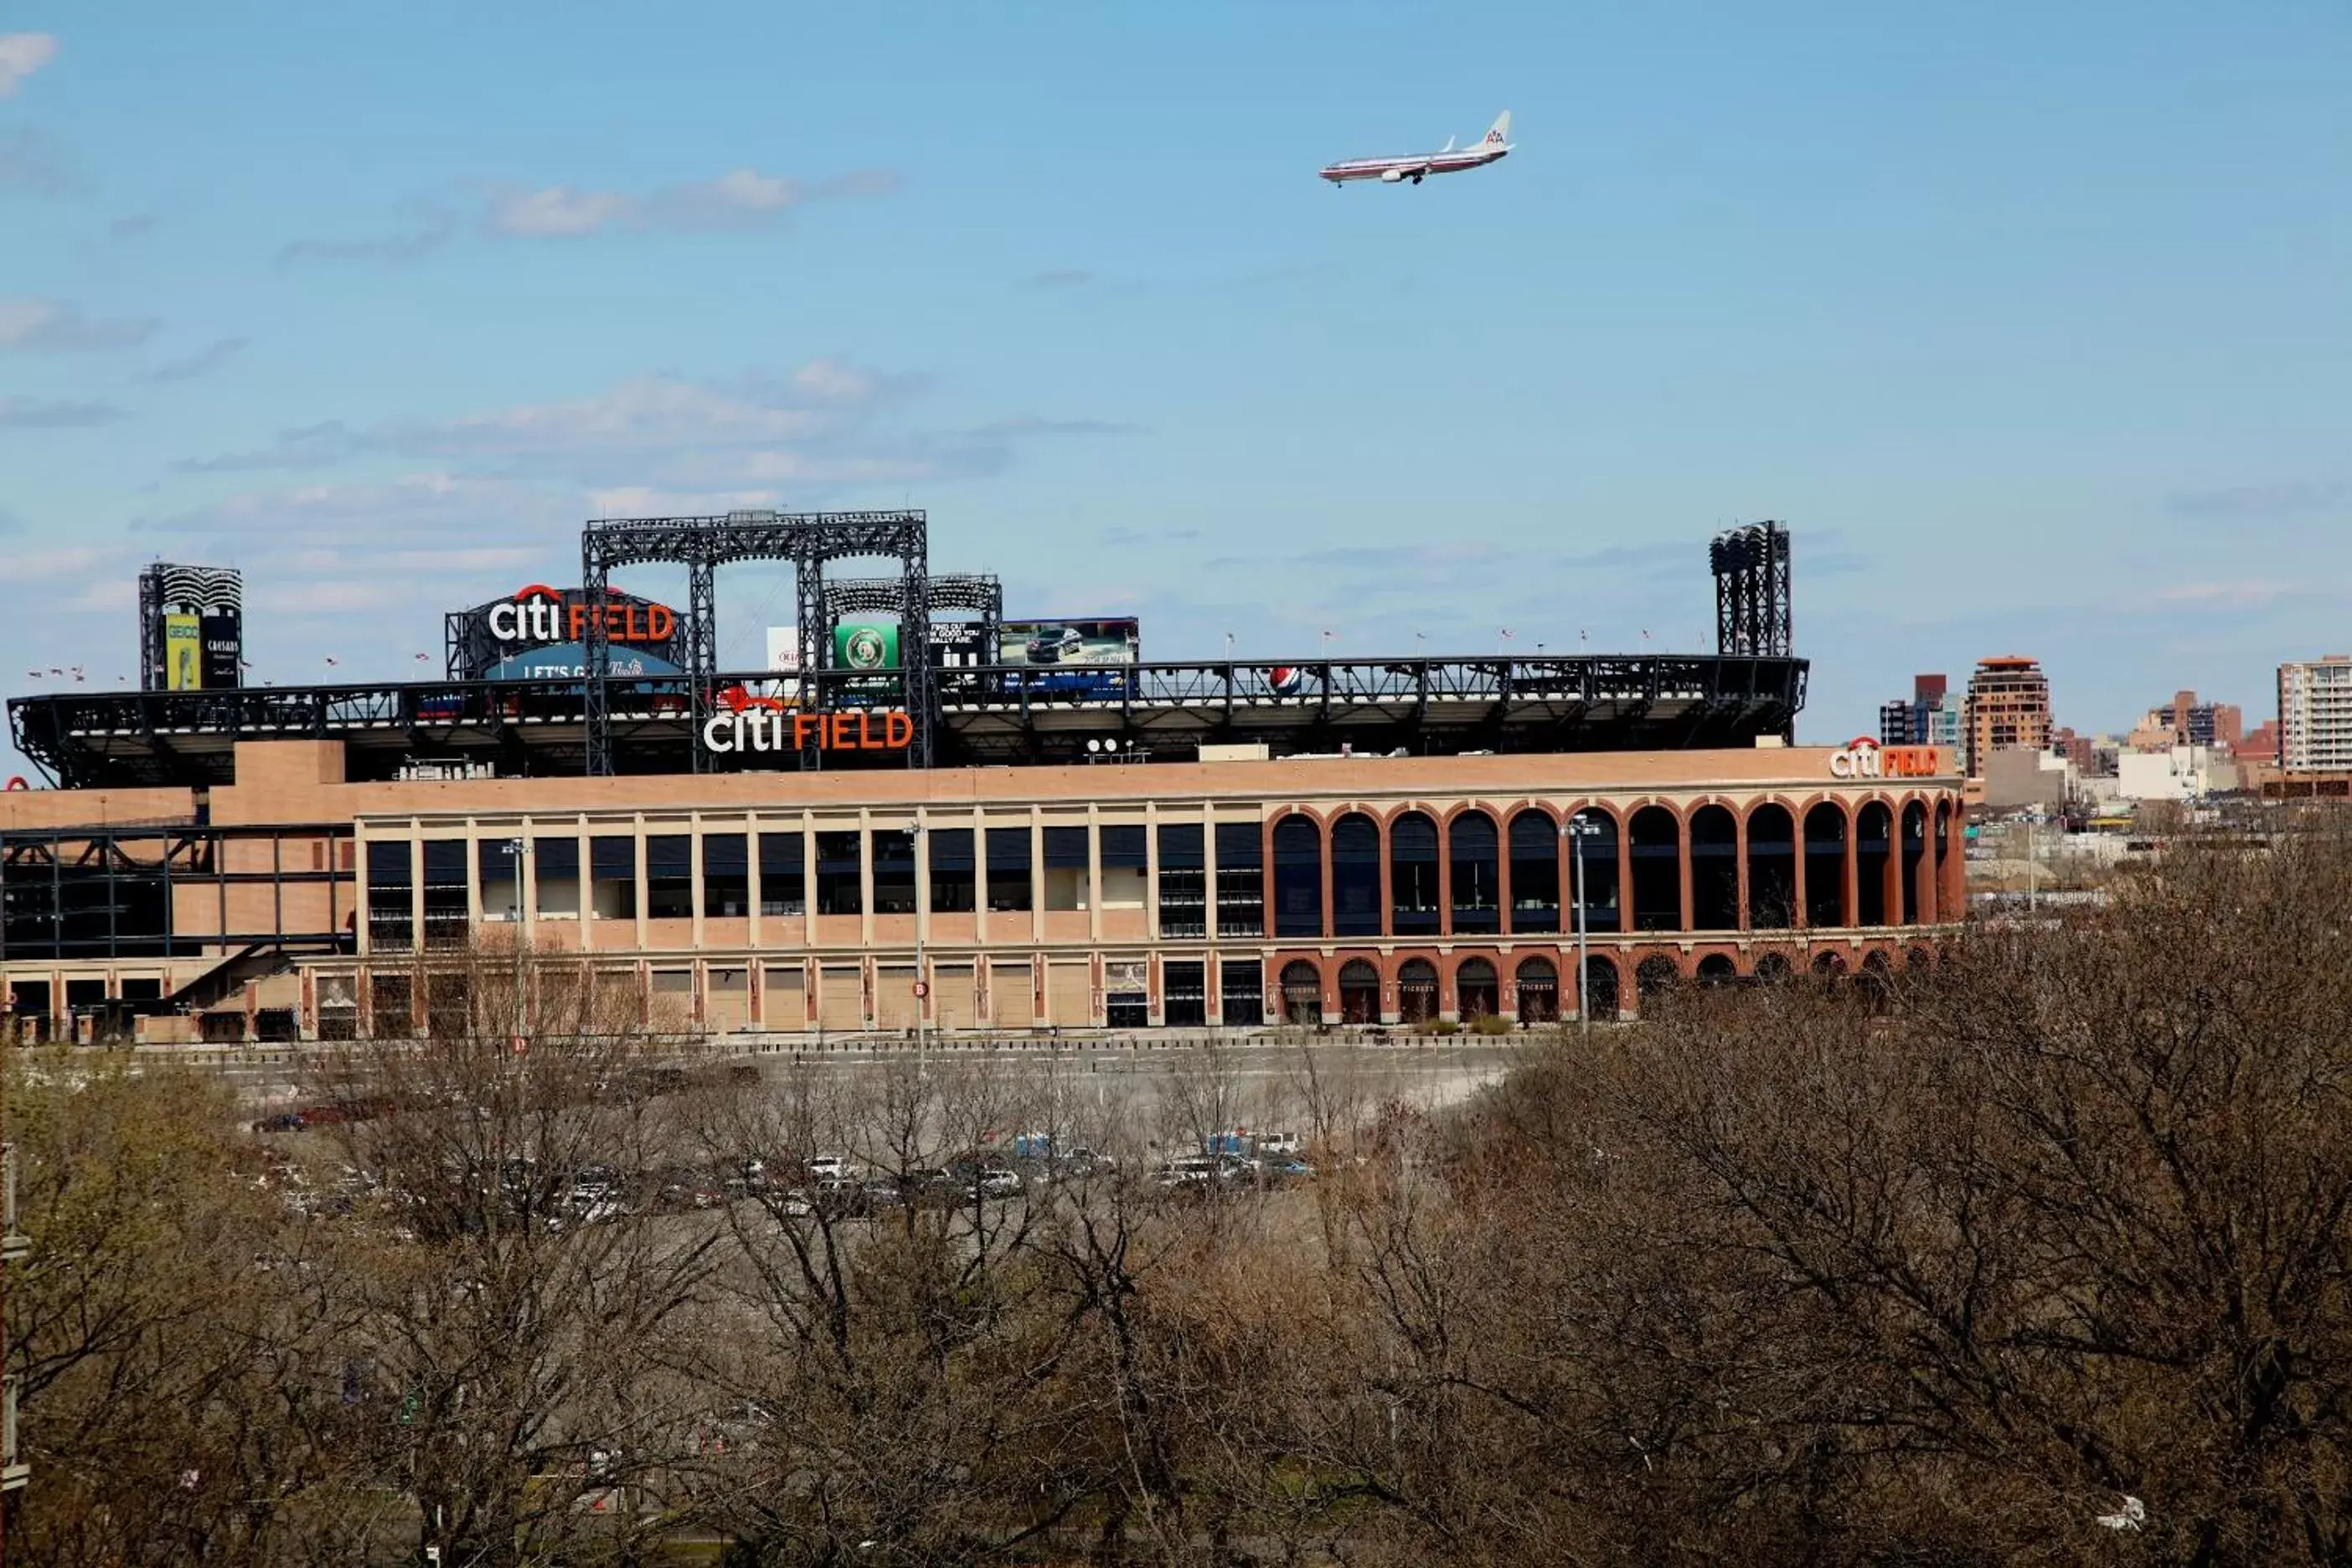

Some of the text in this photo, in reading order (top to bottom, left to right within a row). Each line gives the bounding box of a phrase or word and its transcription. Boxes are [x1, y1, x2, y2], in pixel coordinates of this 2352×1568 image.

[569, 604, 674, 642] FIELD
[207, 640, 239, 652] CAESARS
[794, 713, 914, 750] FIELD
